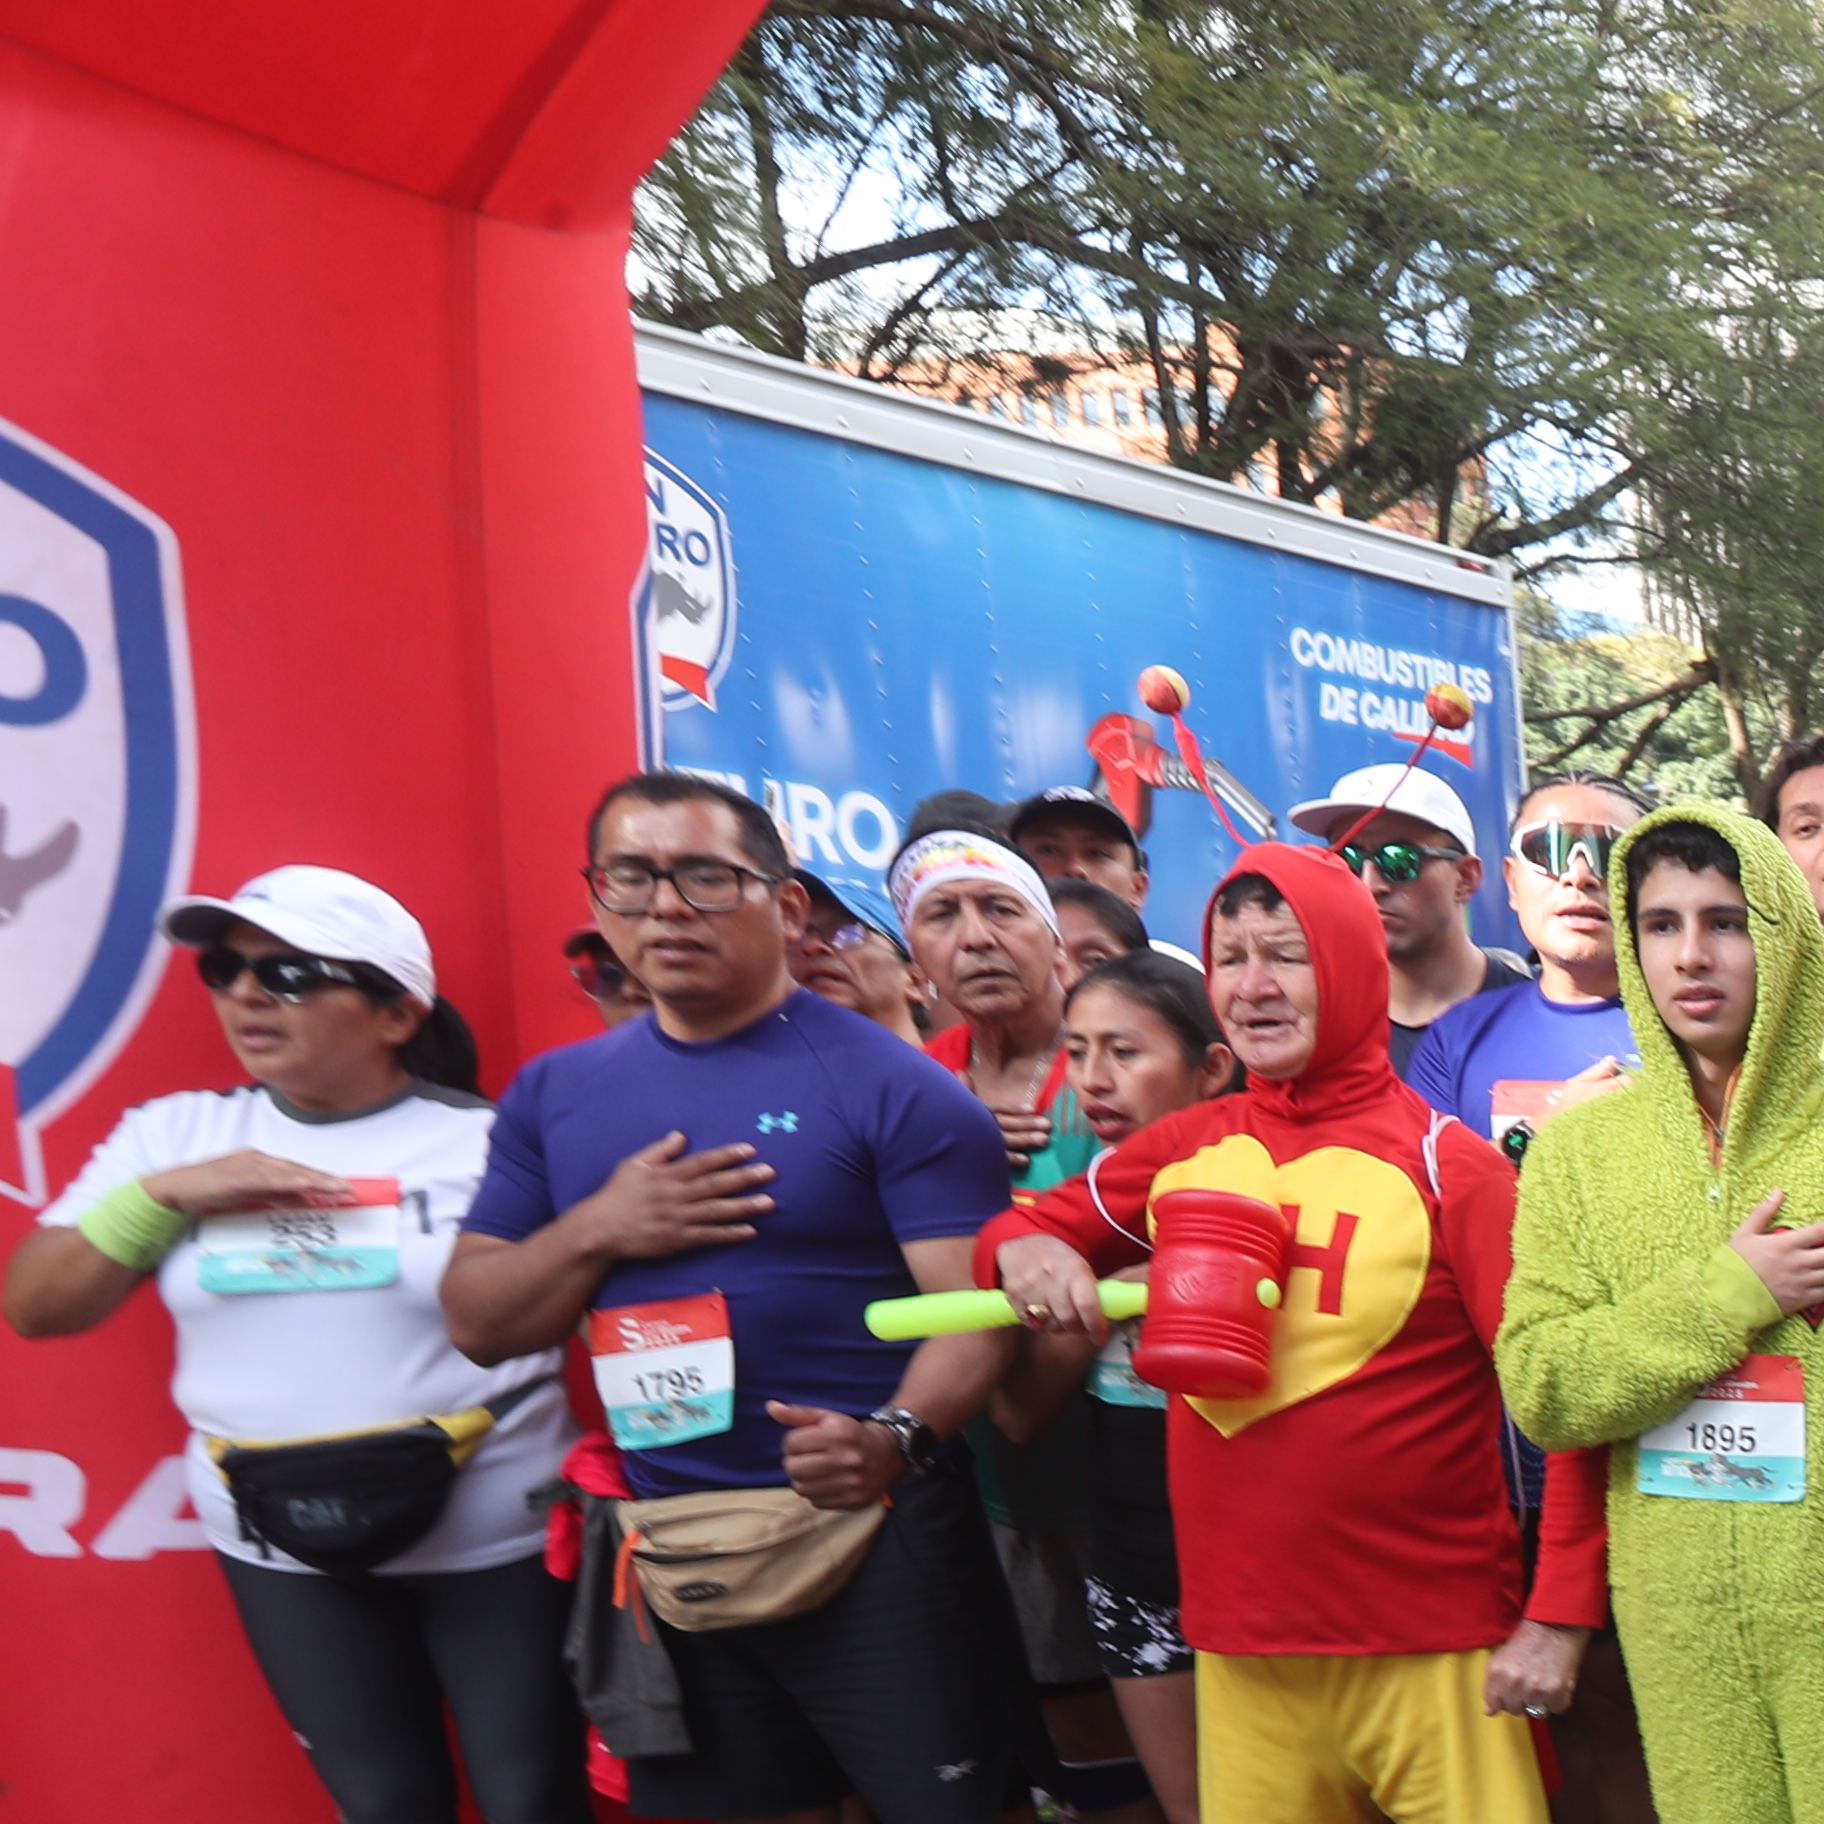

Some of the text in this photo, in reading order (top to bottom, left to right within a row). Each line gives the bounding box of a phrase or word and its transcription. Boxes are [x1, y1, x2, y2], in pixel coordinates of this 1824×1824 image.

[1289, 626, 1495, 705] COMBUSTIBLES
[1319, 681, 1476, 746] DE CALID
[631, 1364, 705, 1402] 1795
[1684, 1421, 1757, 1454] 1895
